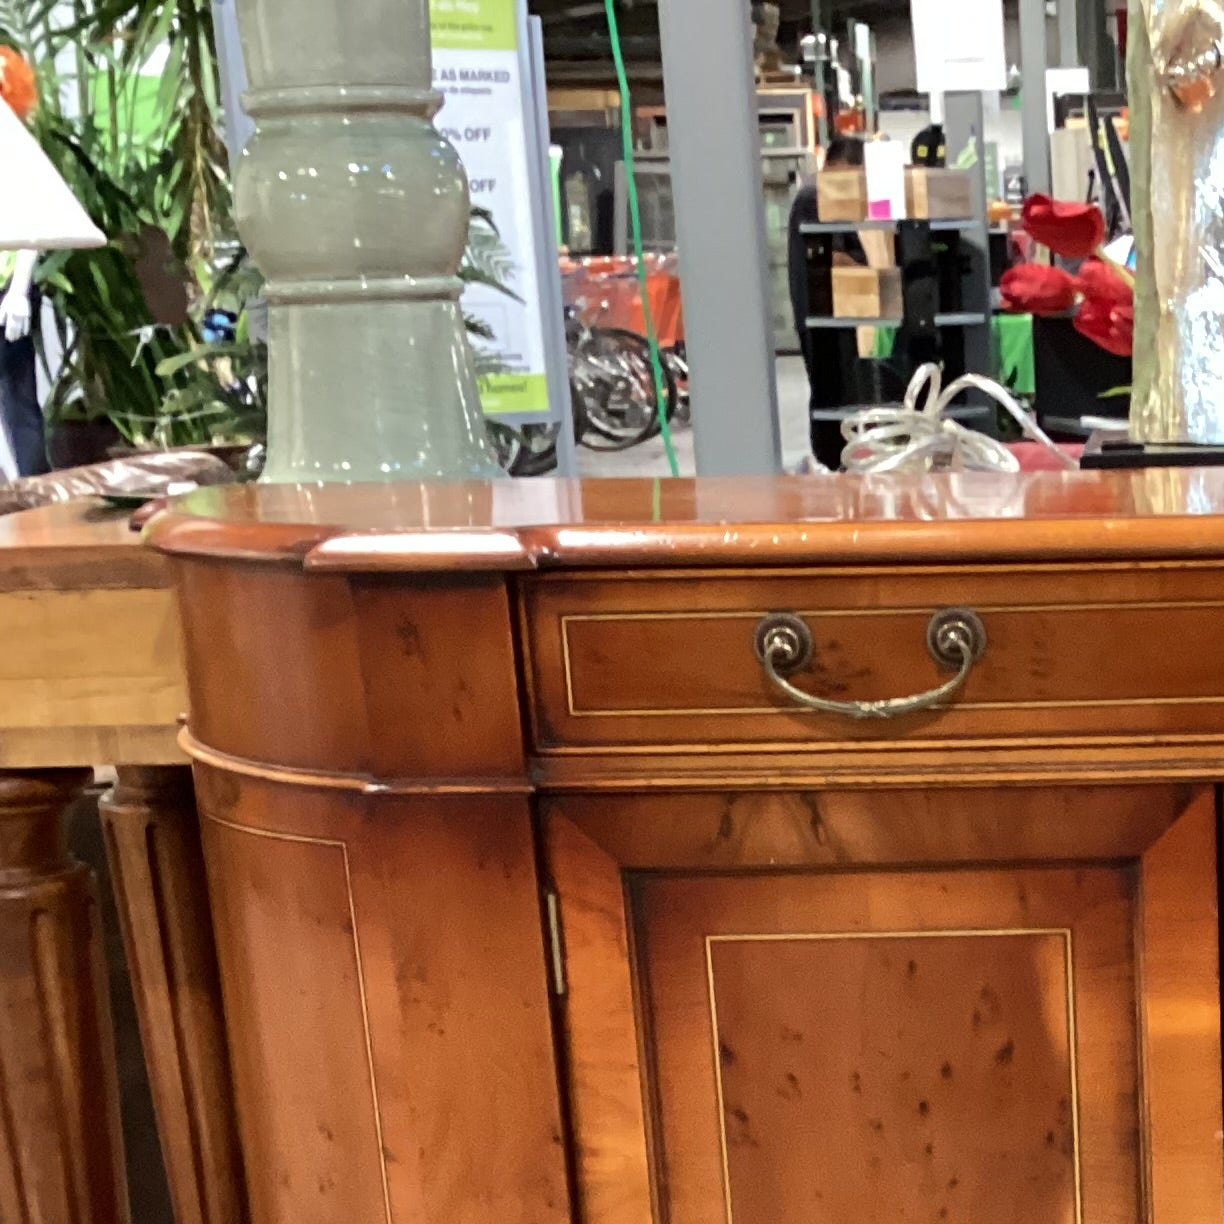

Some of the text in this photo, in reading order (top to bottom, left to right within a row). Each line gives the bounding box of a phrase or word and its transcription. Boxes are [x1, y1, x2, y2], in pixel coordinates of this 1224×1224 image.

[441, 69, 510, 83] AS MARKED
[464, 127, 491, 141] OFF
[470, 179, 496, 193] OFF
